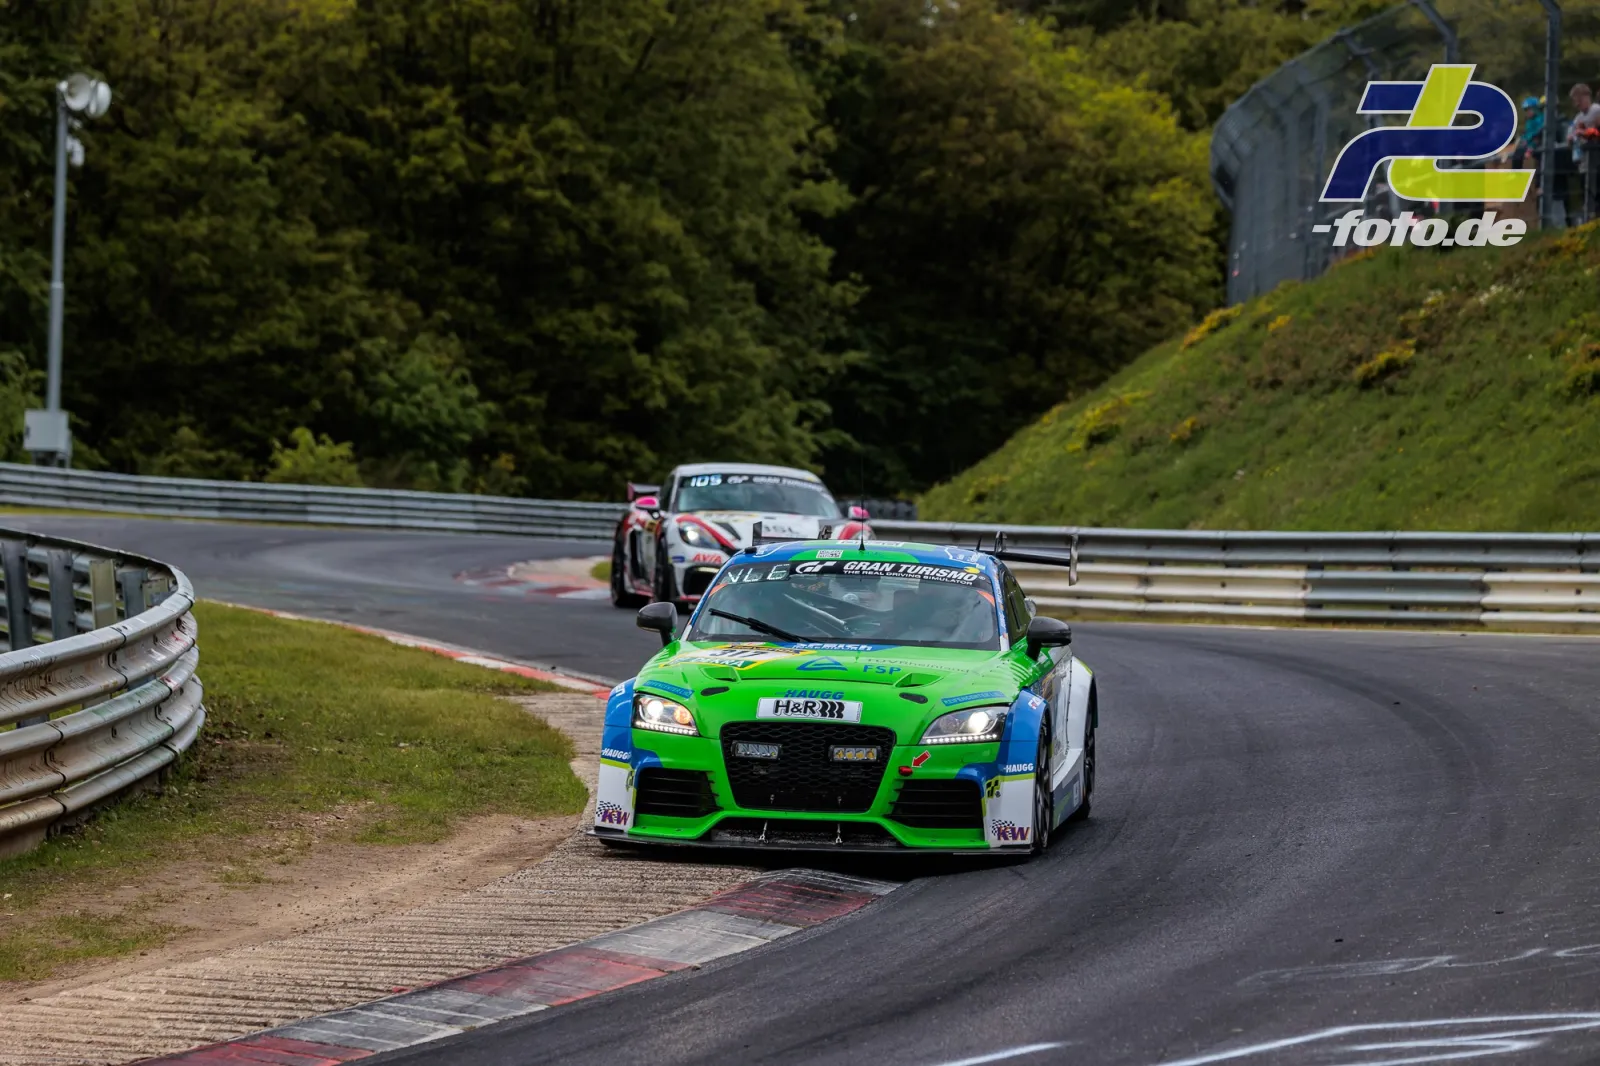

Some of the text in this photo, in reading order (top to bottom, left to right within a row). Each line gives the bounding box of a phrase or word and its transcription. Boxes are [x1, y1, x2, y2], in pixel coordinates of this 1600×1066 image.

[692, 553, 722, 565] AVIA
[843, 561, 978, 581] GRAN TURISMO
[923, 575, 973, 586] SIMULATOR
[863, 665, 902, 676] FSP
[784, 689, 845, 700] HAUGG
[774, 699, 819, 716] H&R
[601, 748, 629, 760] HAUGG
[1004, 763, 1034, 773] HAUGG
[601, 809, 630, 826] KW
[996, 826, 1030, 841] KW
